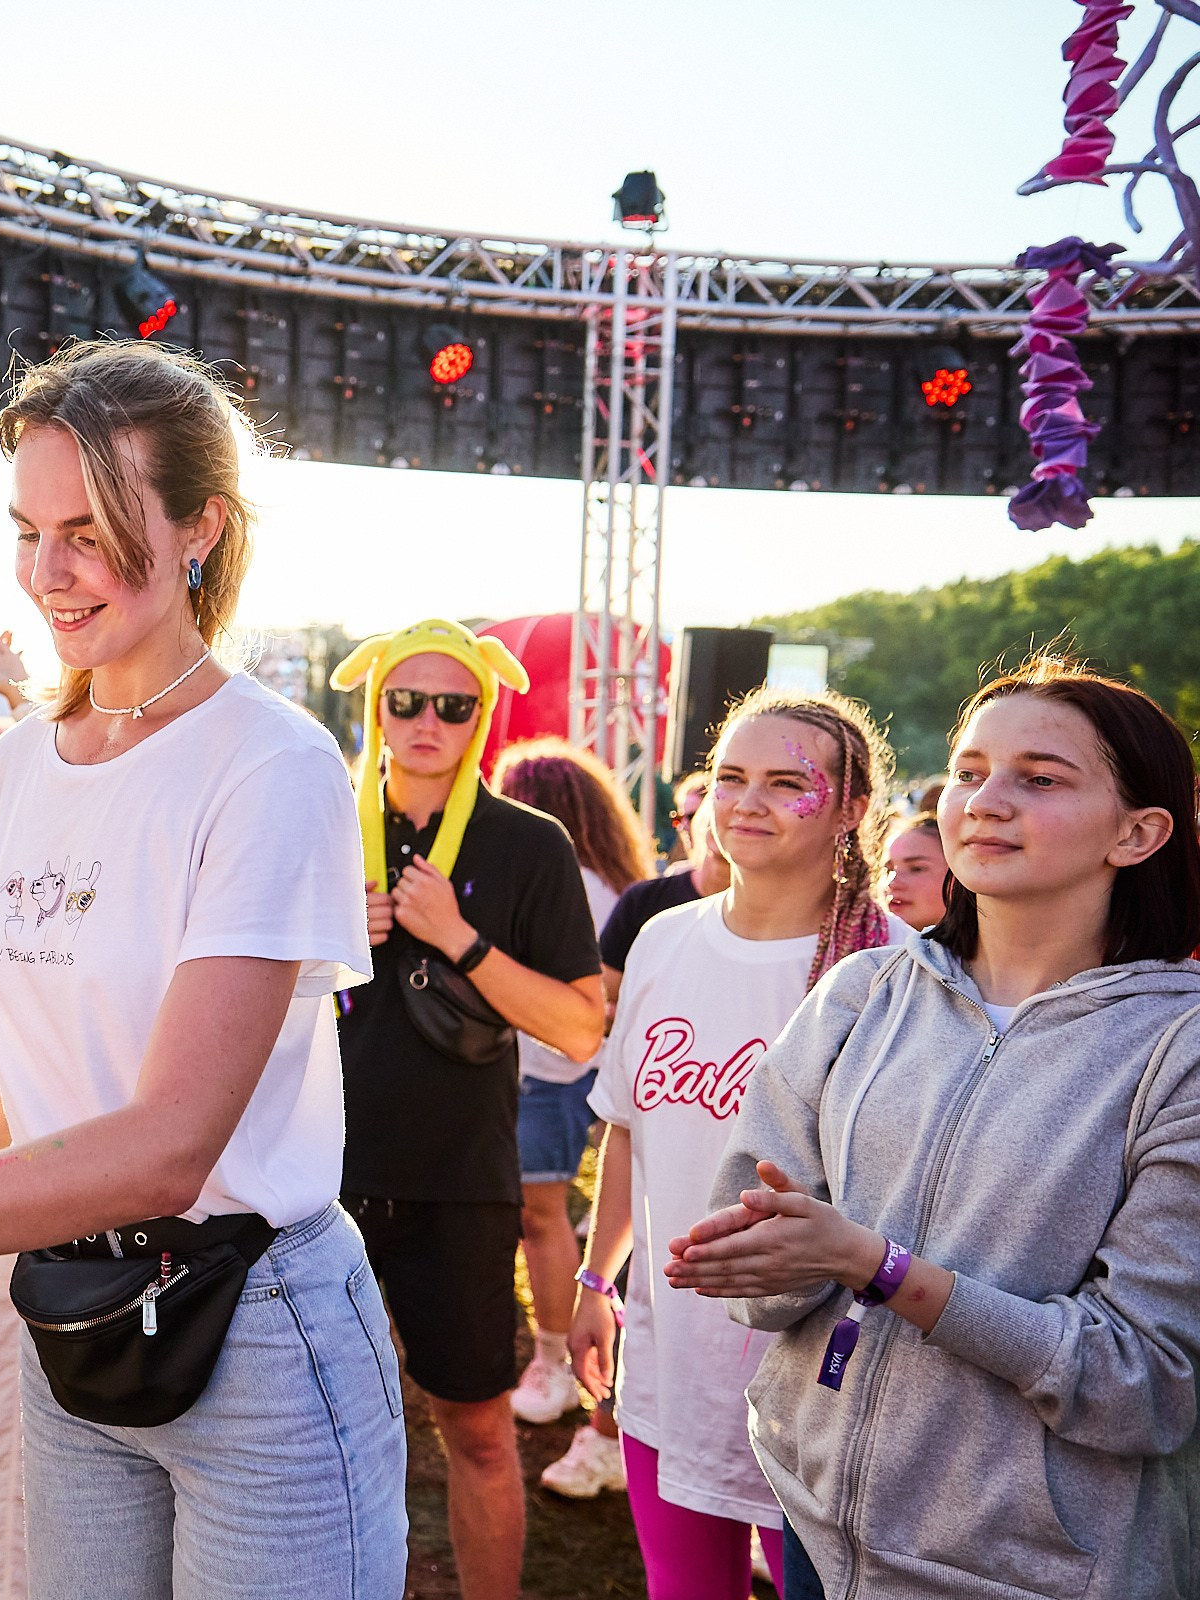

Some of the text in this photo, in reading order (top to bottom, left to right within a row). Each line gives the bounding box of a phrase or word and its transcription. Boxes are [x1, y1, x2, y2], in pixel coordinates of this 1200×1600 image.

[6, 947, 36, 964] BEING
[634, 1017, 767, 1120] Barb
[828, 1351, 845, 1375] VISA
